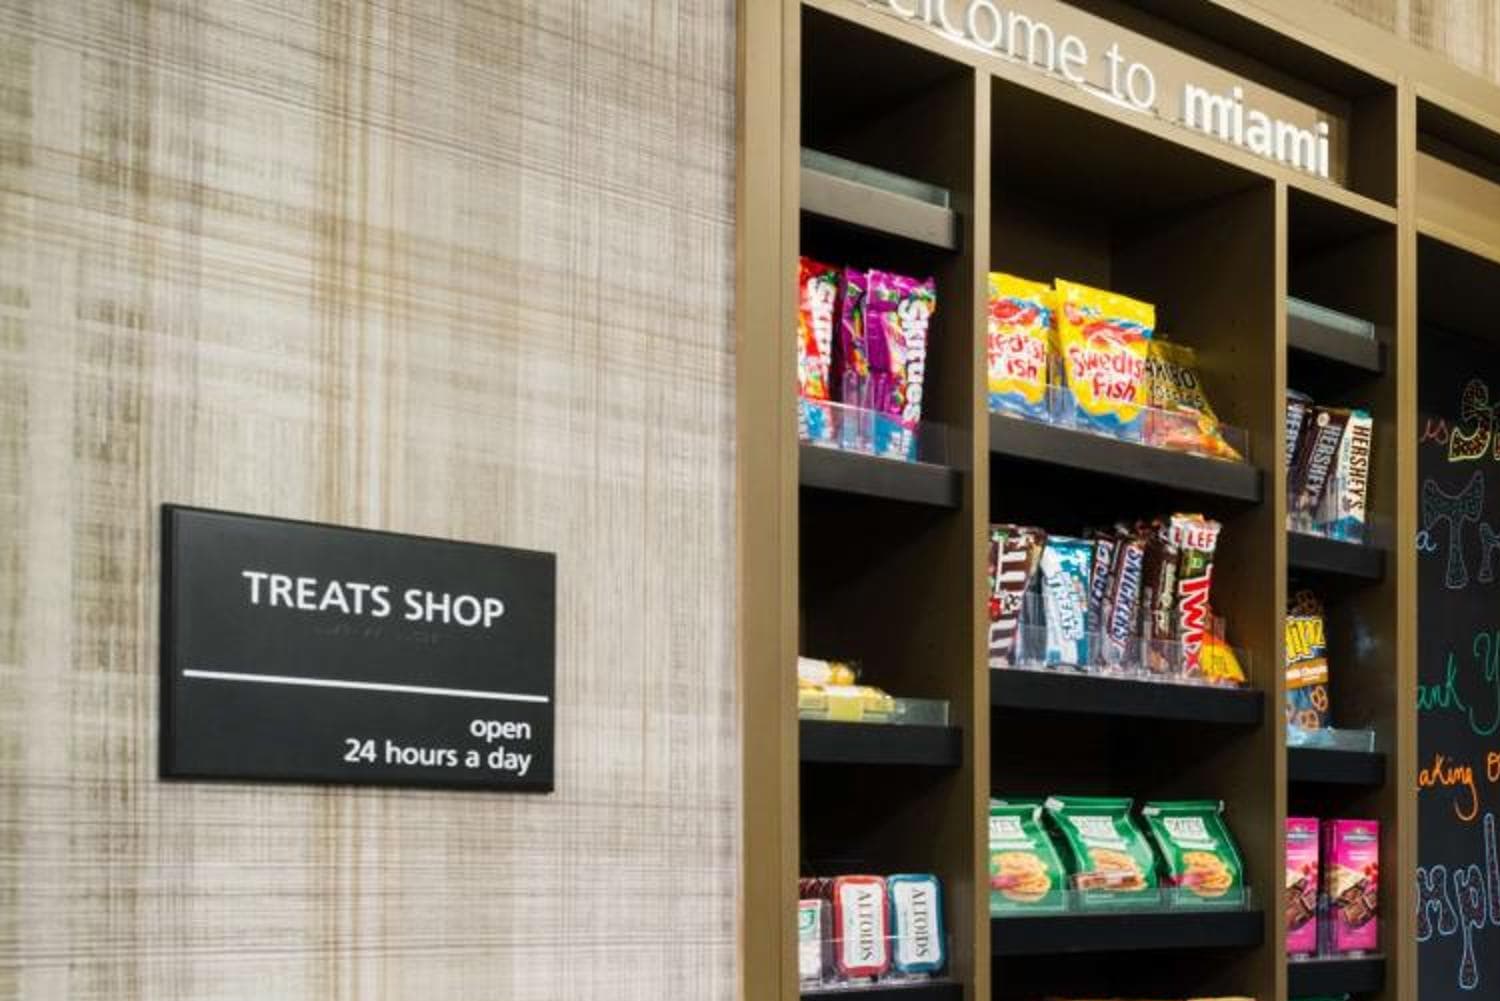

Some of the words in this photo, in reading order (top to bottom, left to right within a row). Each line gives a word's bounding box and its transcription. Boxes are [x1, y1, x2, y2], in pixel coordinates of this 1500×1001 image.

[888, 0, 1087, 84] come
[1105, 42, 1156, 109] to
[1185, 81, 1330, 178] miami
[1348, 425, 1372, 511] HERSHEY'S
[243, 570, 392, 617] TREATS
[404, 589, 505, 628] SHOP
[1178, 564, 1213, 673] TWIX
[1415, 652, 1466, 712] ank
[344, 738, 377, 763] 24
[386, 740, 458, 767] hours
[465, 749, 480, 767] a
[488, 746, 532, 775] day
[469, 719, 531, 745] open
[1416, 755, 1478, 821] aking
[856, 888, 873, 964] ALTOIDS
[915, 887, 930, 960] ALTOIDS
